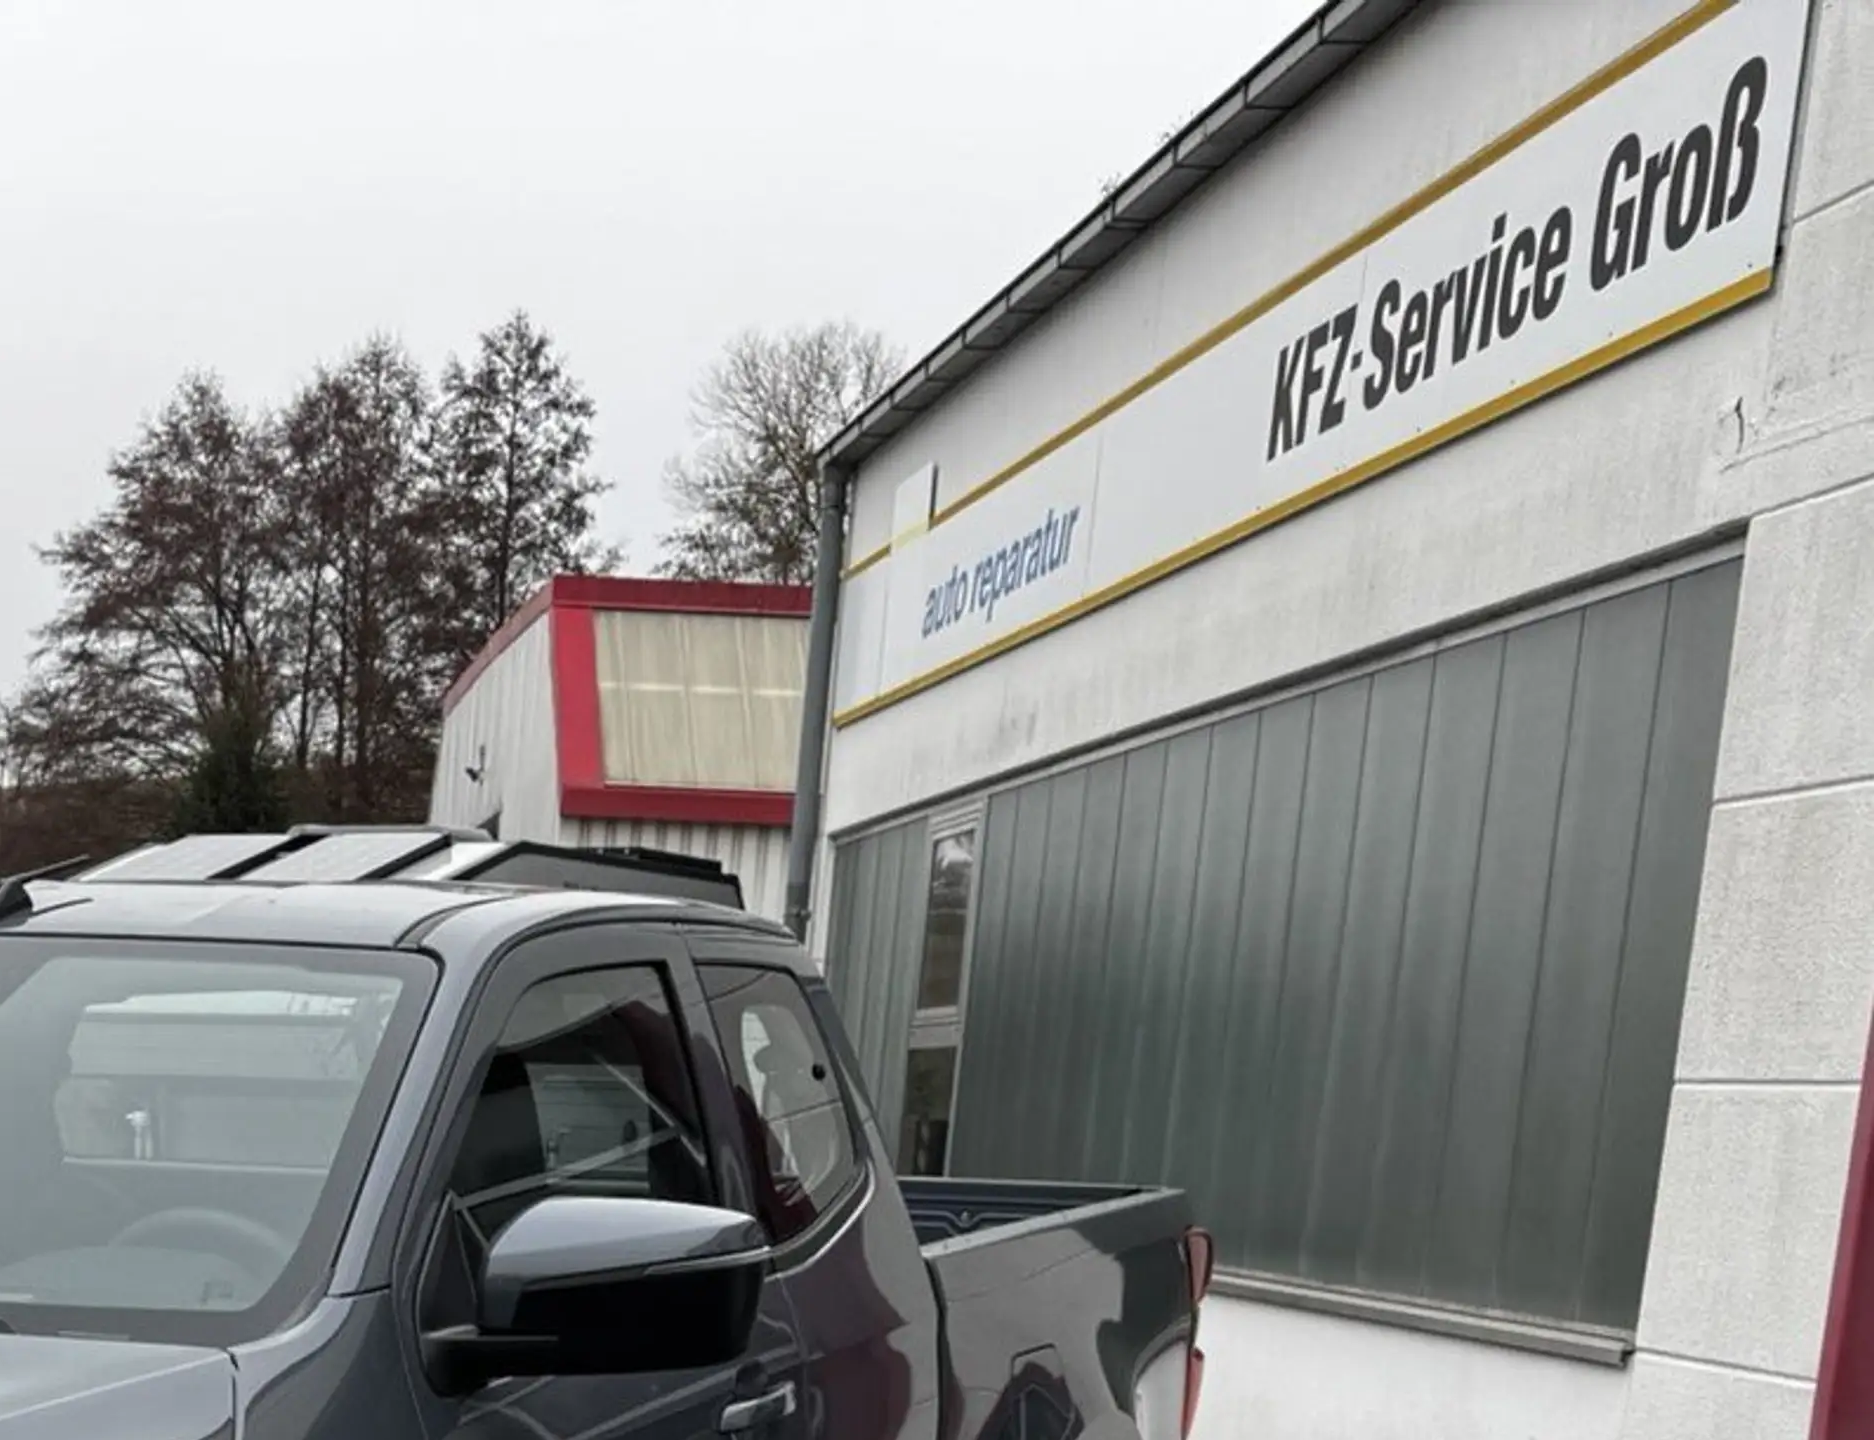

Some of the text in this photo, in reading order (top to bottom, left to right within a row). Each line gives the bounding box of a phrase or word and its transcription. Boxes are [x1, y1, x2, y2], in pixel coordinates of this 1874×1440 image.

[1266, 56, 1768, 461] KFZ-Service Groß
[922, 506, 1081, 639] auto reparatur
